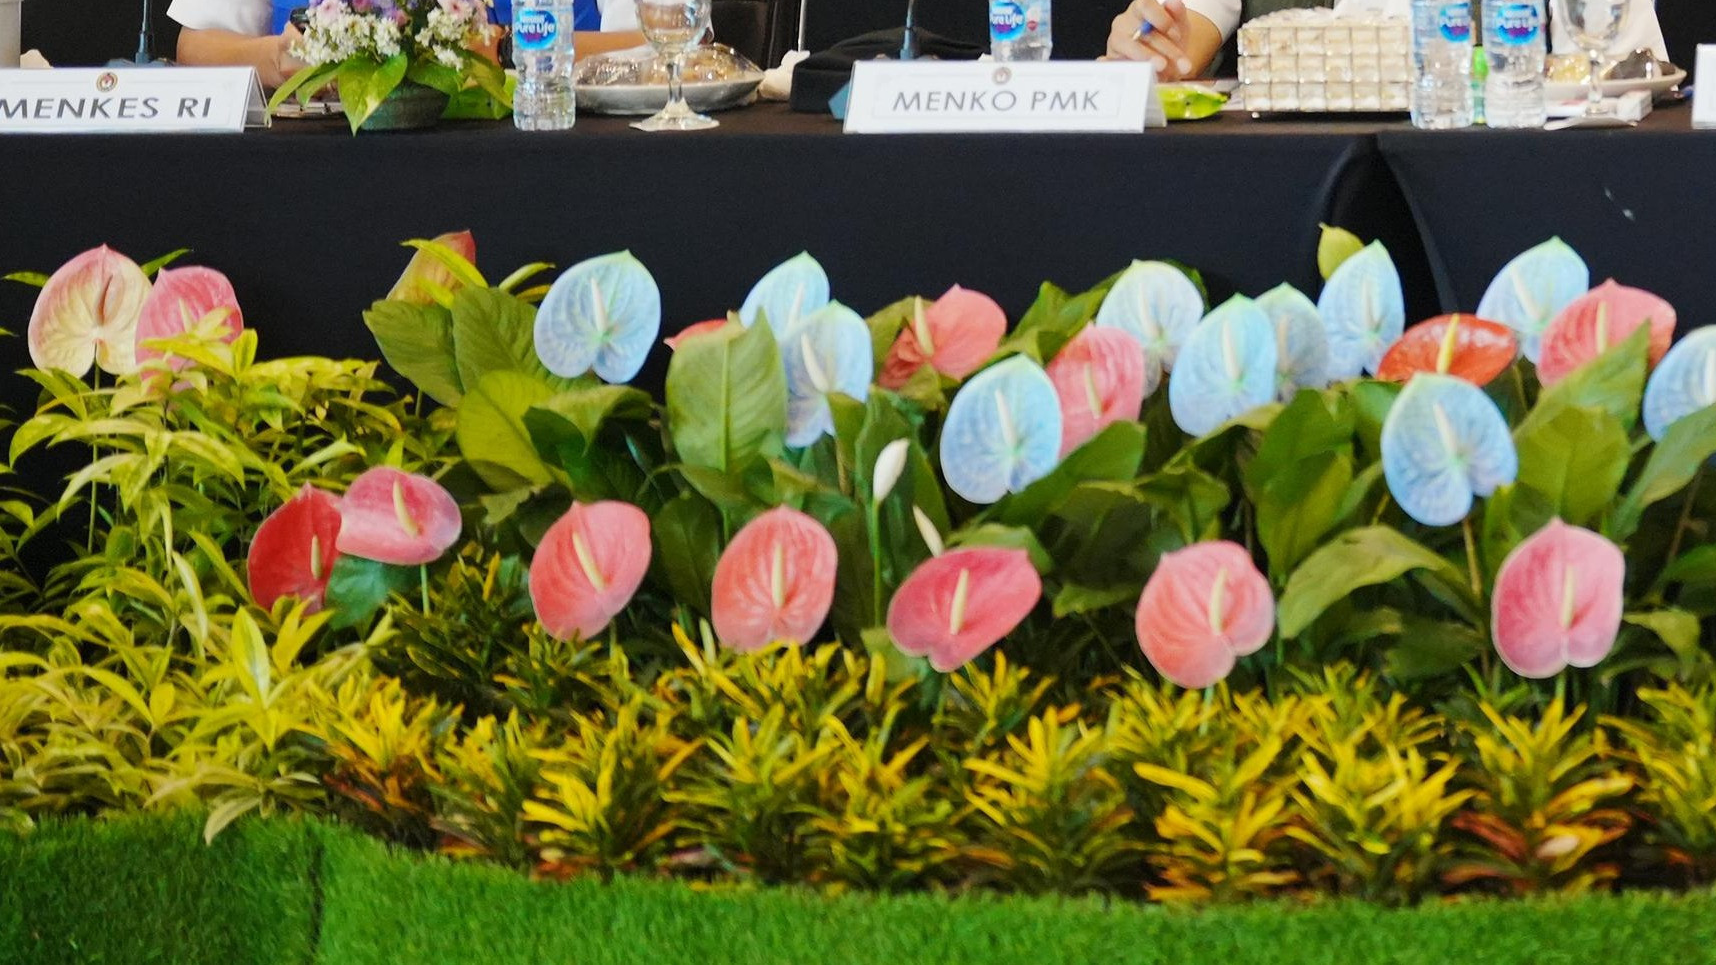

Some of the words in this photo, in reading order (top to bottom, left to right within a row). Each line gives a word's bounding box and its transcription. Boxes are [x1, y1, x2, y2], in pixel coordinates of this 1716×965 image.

[0, 97, 160, 119] MENKES
[176, 96, 212, 118] RI
[892, 90, 1017, 112] MENKO
[1030, 90, 1100, 111] PMK
